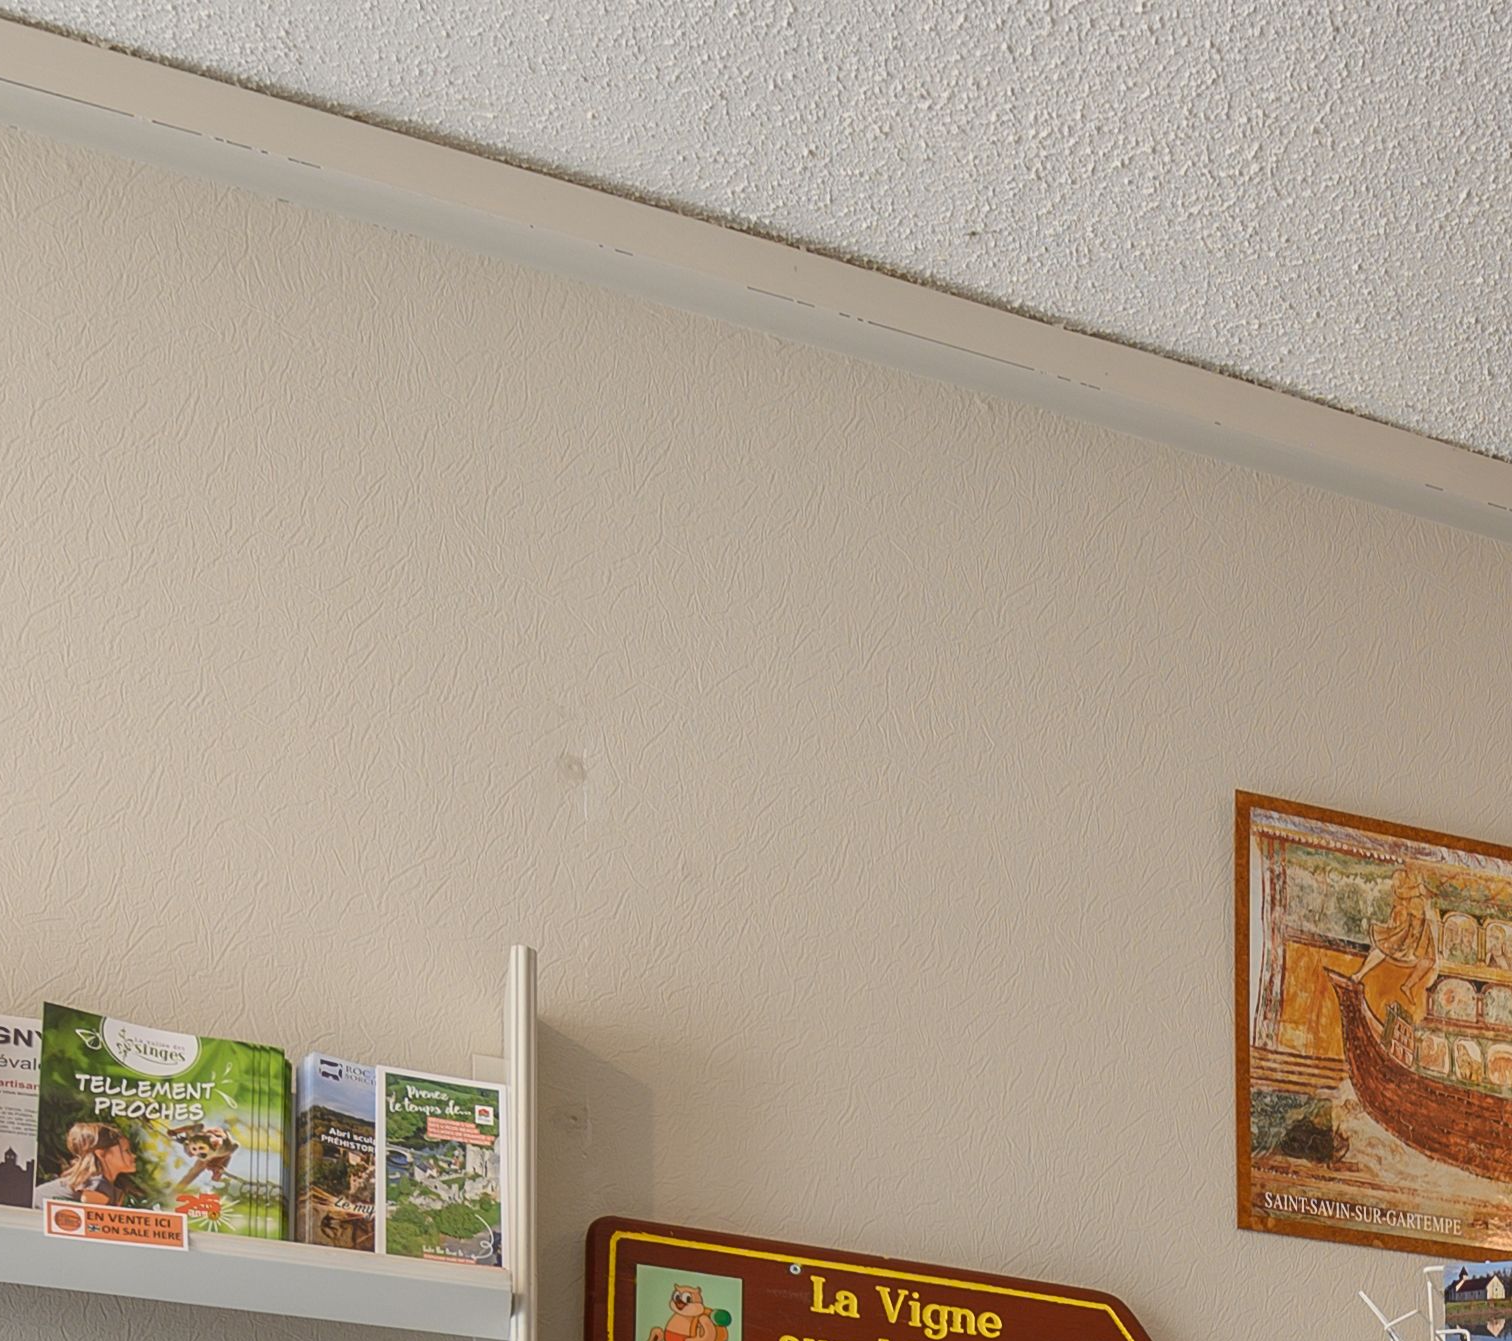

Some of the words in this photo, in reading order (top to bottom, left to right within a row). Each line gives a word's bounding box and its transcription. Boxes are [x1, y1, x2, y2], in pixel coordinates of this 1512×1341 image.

[75, 1074, 215, 1100] TELLEMENT
[94, 1097, 204, 1121] PROCHES
[87, 1211, 104, 1222] EN
[110, 1212, 151, 1227] VENTE
[155, 1215, 171, 1228] ICI
[1264, 1191, 1462, 1236] SAINT-SAVIN-SUR-GARTEMPE
[102, 1226, 120, 1235] ON
[123, 1227, 150, 1238] SALE
[153, 1230, 182, 1241] HERE
[810, 1276, 860, 1318] La
[876, 1286, 1002, 1339] Vigne
